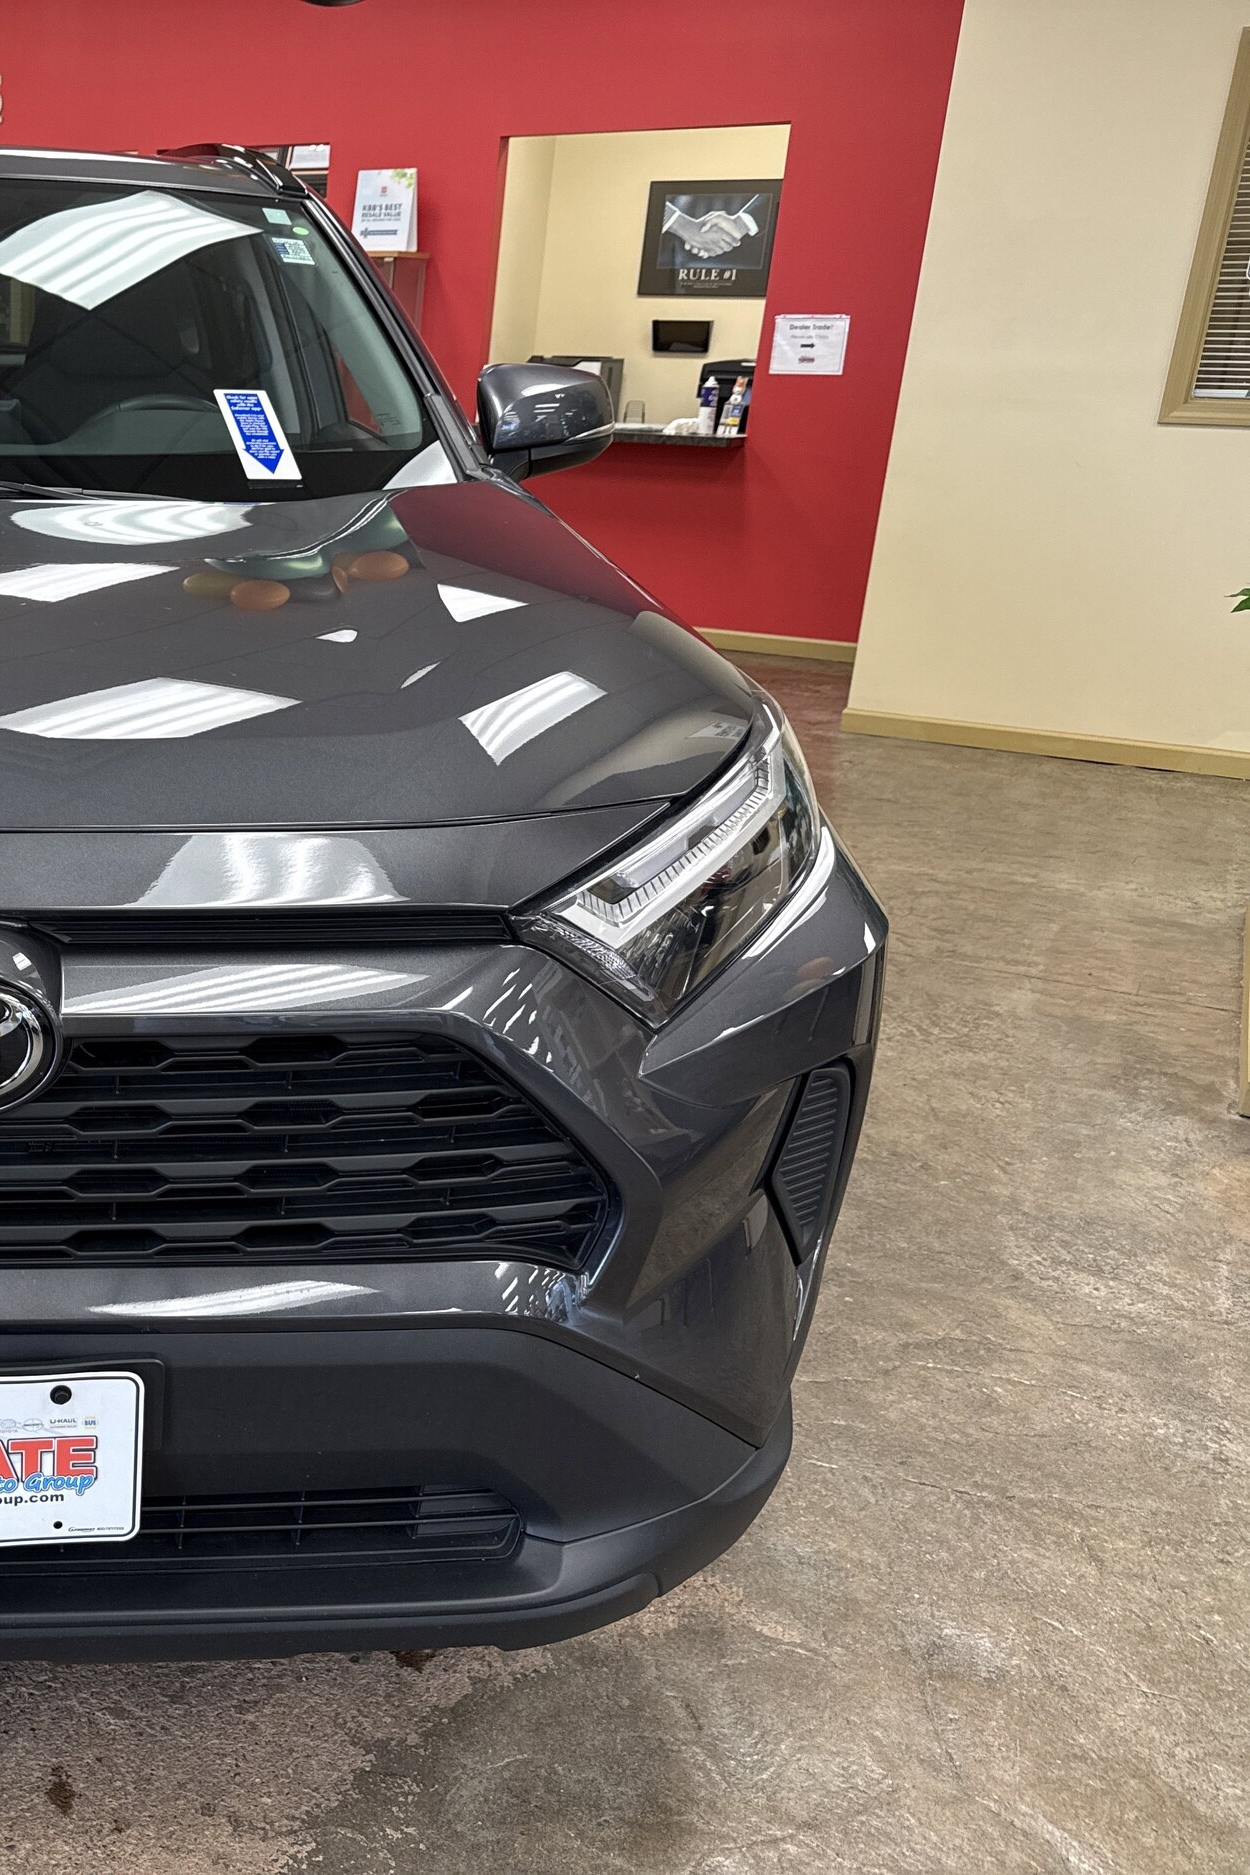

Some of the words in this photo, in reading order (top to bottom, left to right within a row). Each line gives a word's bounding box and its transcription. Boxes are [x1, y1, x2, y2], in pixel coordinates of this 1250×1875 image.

[384, 203, 403, 211] BEST
[678, 268, 720, 280] RULE
[723, 268, 737, 280] #1
[789, 323, 811, 331] Dealer
[23, 1472, 96, 1496] Group
